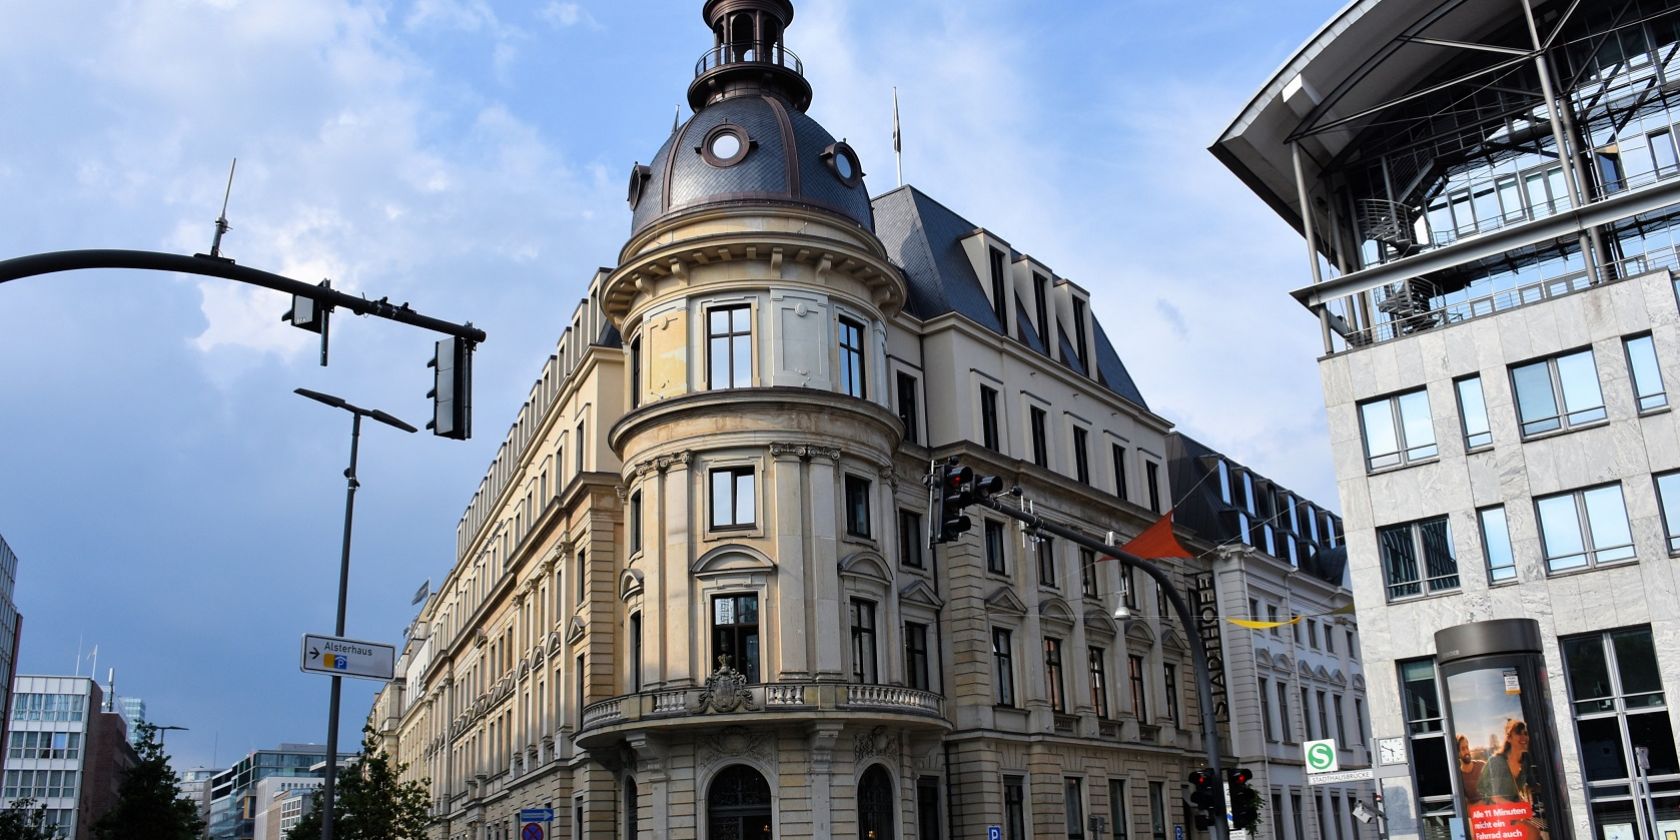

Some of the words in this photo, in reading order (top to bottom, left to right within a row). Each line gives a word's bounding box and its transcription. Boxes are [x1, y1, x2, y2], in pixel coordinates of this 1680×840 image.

[324, 642, 373, 656] Alsterhaus
[1312, 745, 1330, 767] S
[1473, 810, 1484, 818] Alle
[1484, 809, 1492, 817] 11
[1493, 808, 1527, 816] Minuten
[1474, 821, 1493, 829] reicht
[1493, 820, 1506, 828] ein
[1475, 831, 1501, 840] Fahrrad
[1503, 829, 1523, 838] auch
